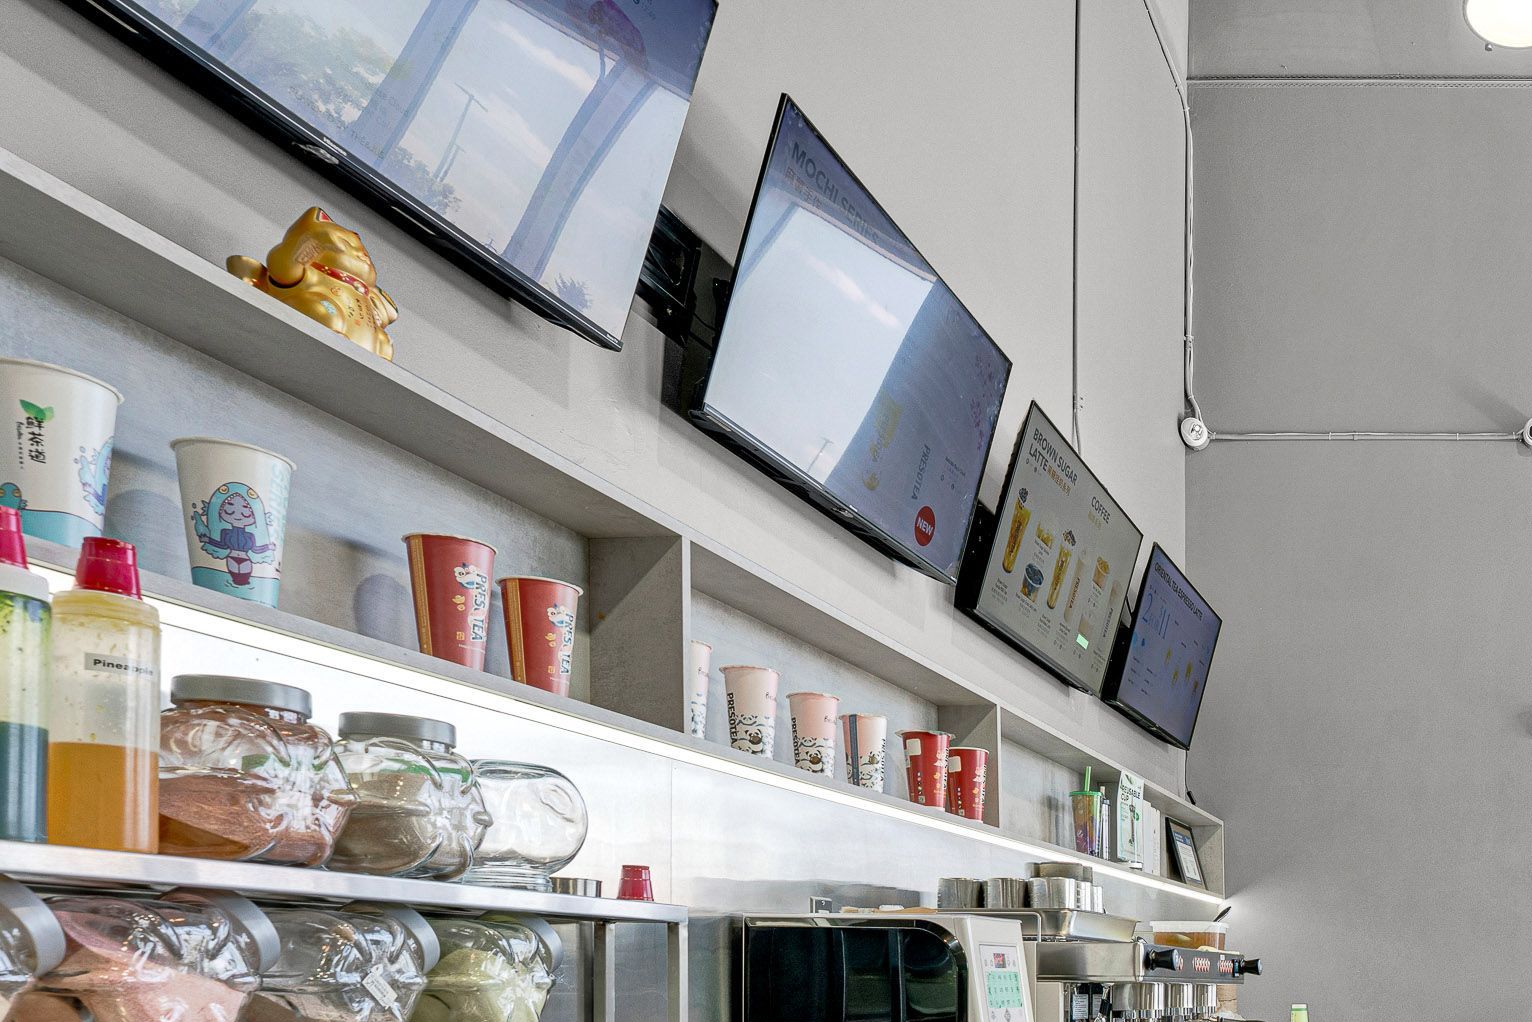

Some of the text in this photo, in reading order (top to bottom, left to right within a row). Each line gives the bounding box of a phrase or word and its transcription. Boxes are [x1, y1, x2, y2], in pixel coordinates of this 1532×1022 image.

[791, 141, 839, 201] MOCHI
[841, 196, 880, 242] SERIES
[911, 444, 932, 500] PRESOTEA
[1029, 443, 1049, 472] LATTE
[1033, 428, 1059, 464] BROWN
[1057, 455, 1078, 486] SUGAR
[916, 517, 934, 536] NEW
[1091, 496, 1111, 524] COFFEE
[727, 692, 738, 745] PRESOTEA
[791, 717, 800, 764] PRESOTEA
